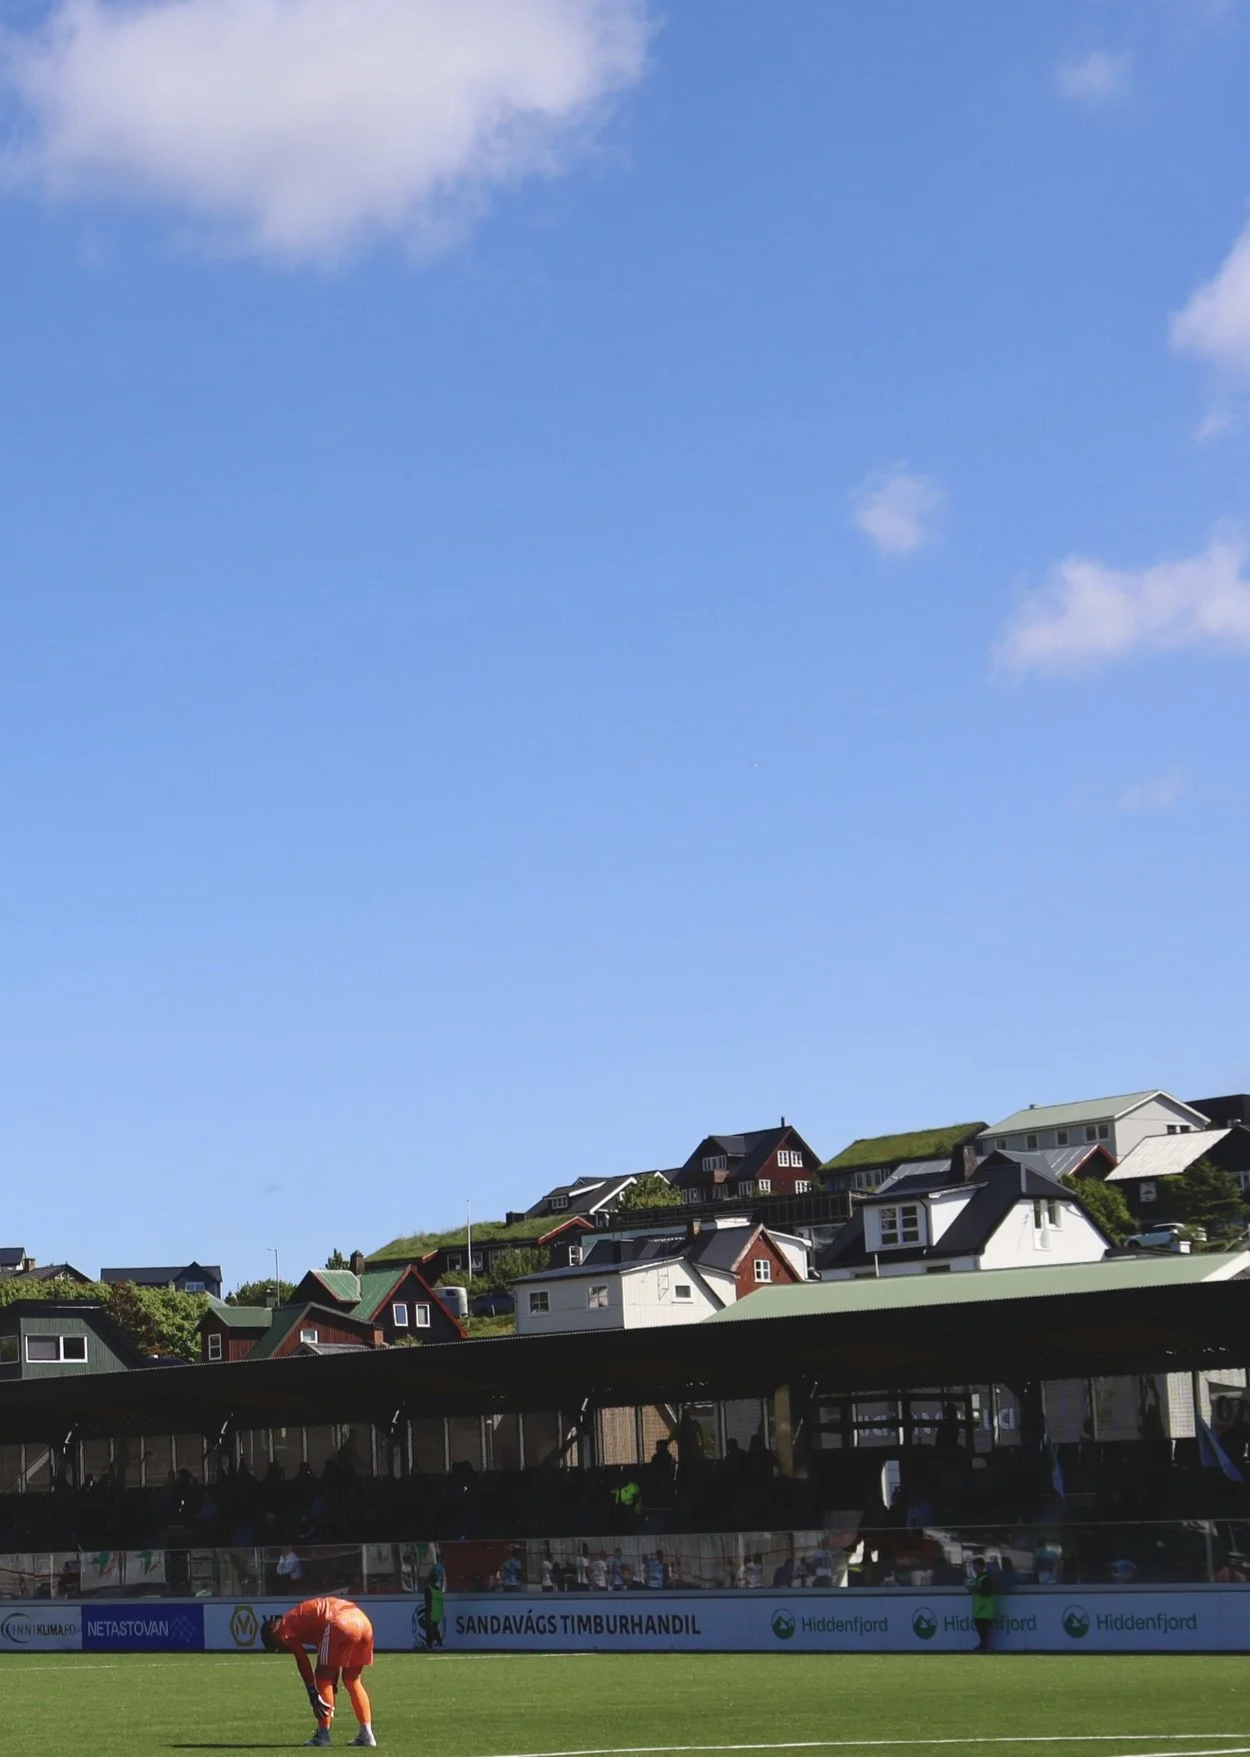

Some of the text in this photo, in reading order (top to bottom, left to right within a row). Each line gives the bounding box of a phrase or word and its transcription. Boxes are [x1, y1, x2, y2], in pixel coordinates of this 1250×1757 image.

[87, 1620, 169, 1637] NETASTOVAN
[455, 1608, 702, 1635] SANDAVÁGS TIMBURHANDIL
[801, 1616, 889, 1636] Hiddenfjord
[1096, 1613, 1198, 1634] Hiddenfjord
